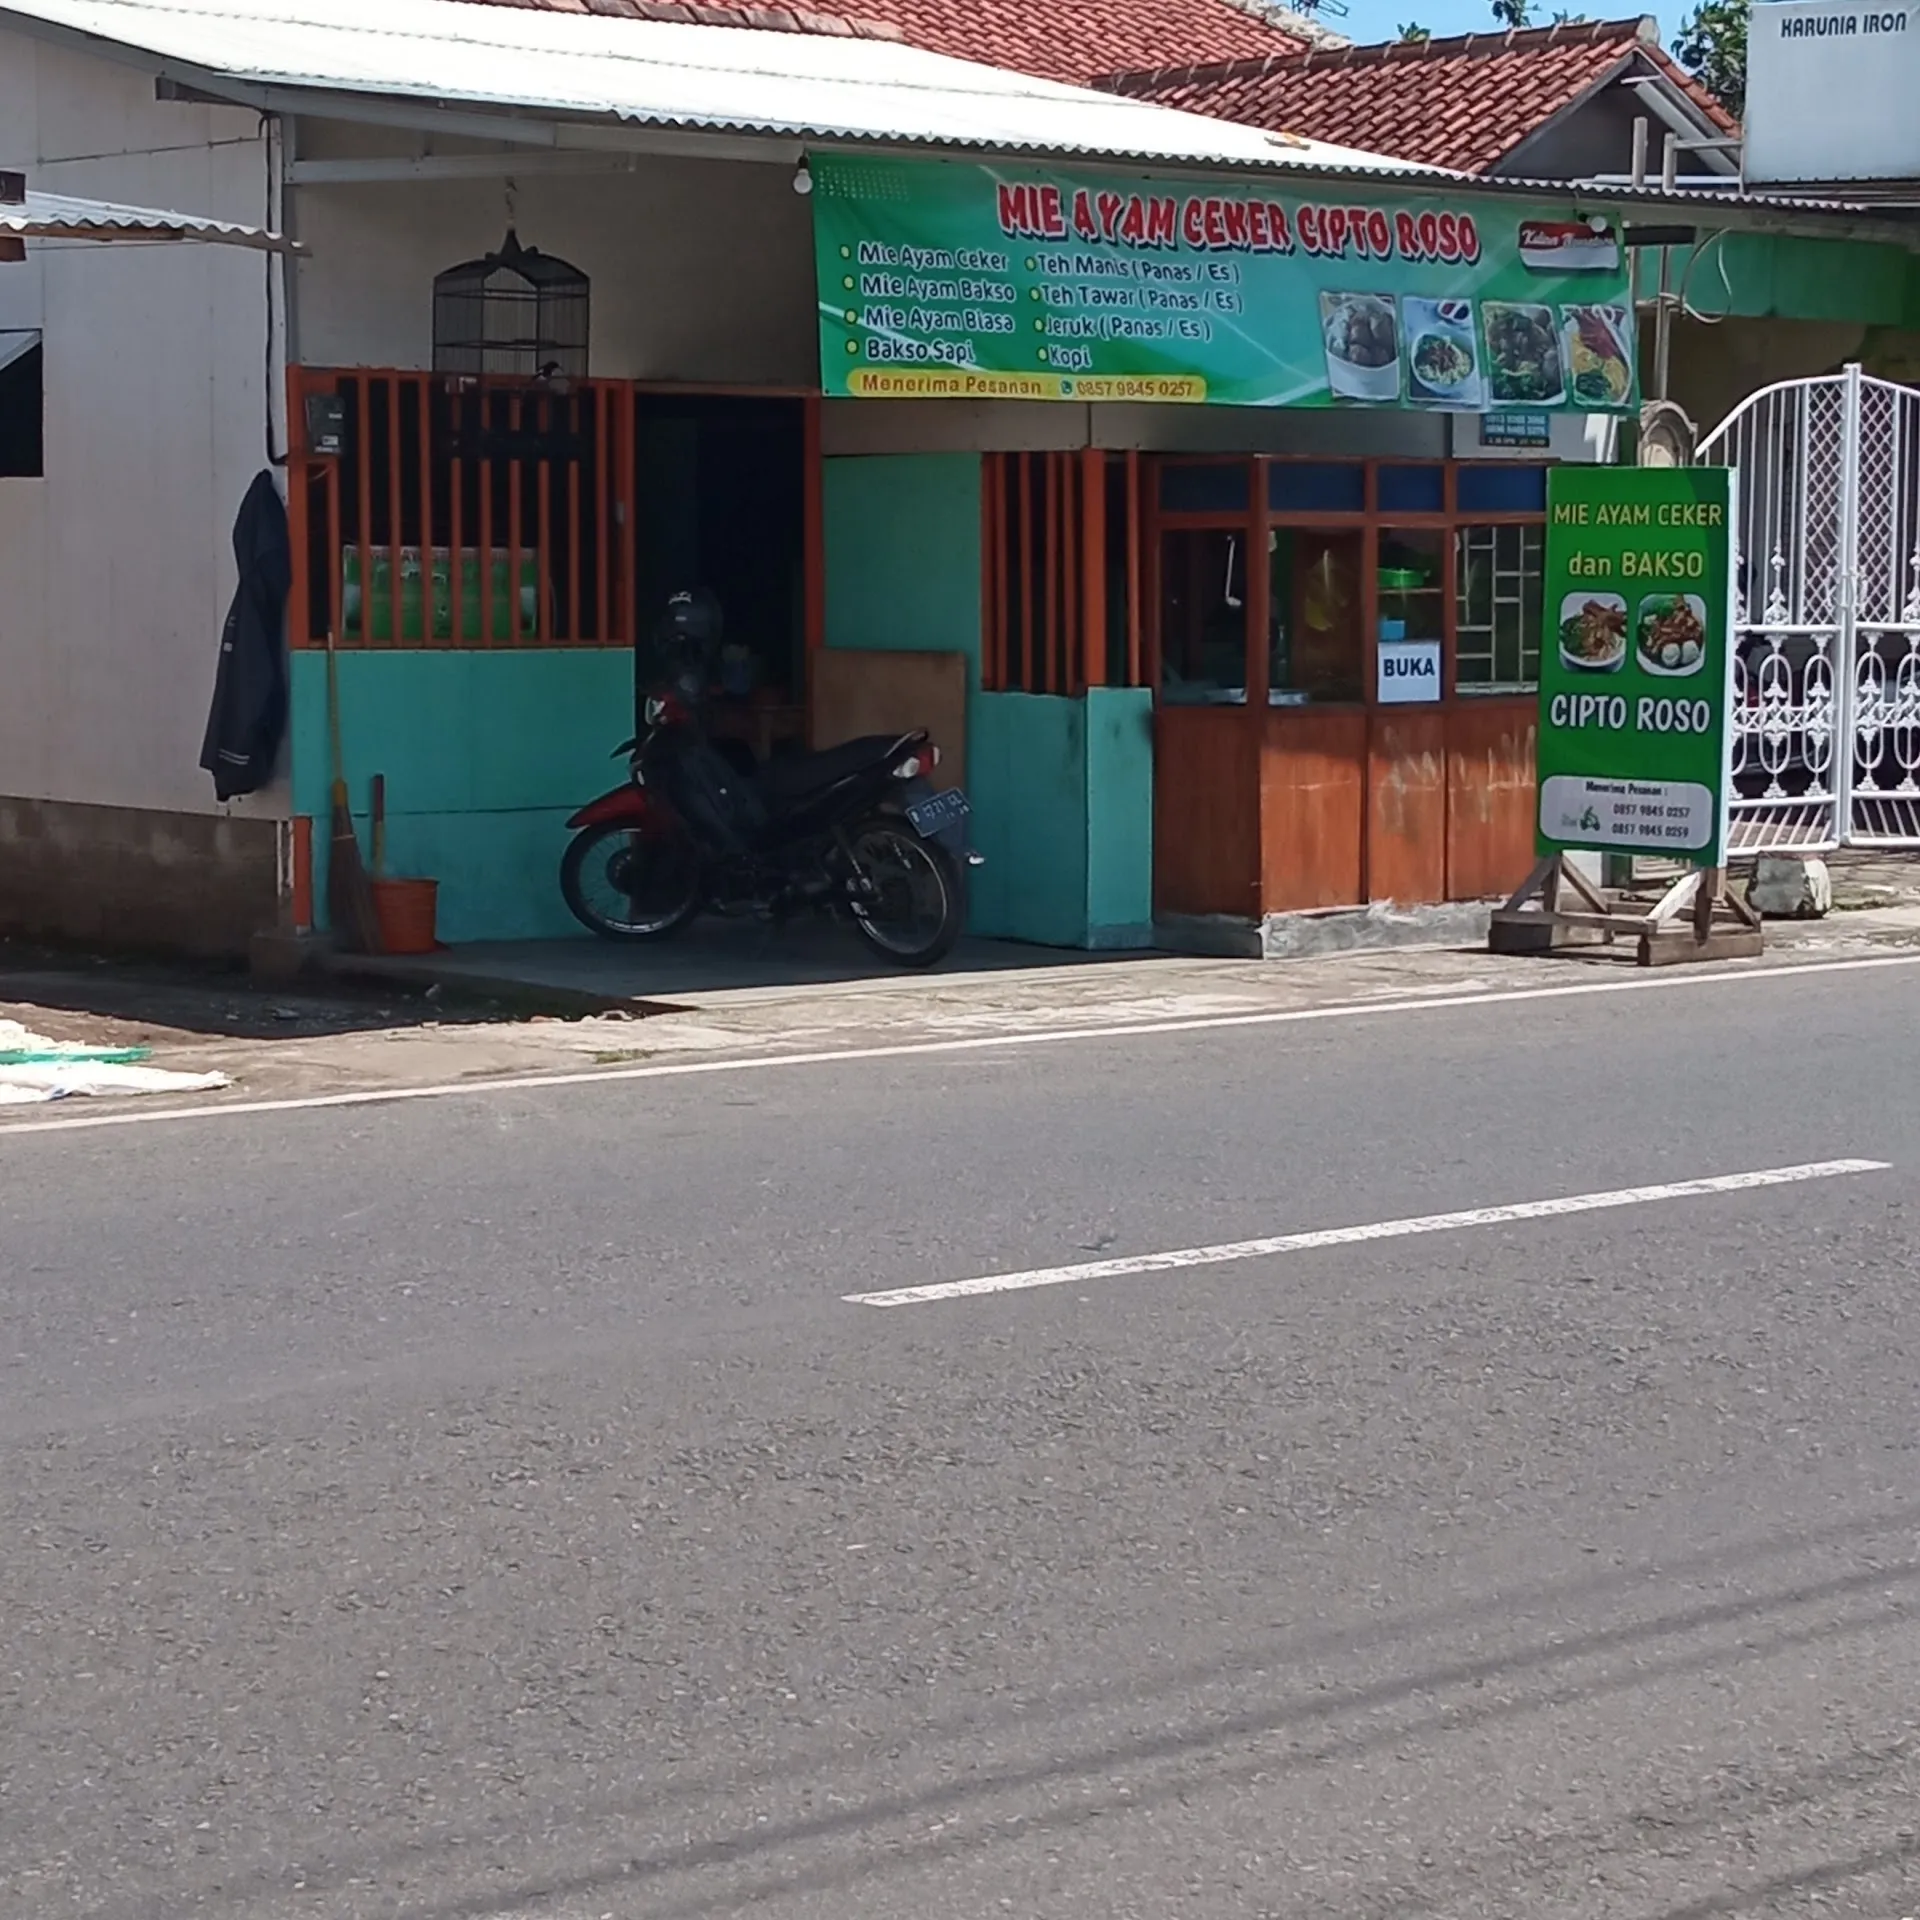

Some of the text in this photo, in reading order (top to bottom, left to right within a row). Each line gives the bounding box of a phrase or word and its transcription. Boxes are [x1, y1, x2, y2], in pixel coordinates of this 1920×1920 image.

[1781, 12, 1907, 38] KARUNIA IRON
[998, 182, 1067, 238] MIE
[1073, 190, 1174, 249] AYAM
[1297, 203, 1392, 261] CIPTO
[1395, 209, 1482, 265] ROSO
[859, 242, 1009, 271] Mie Ayam Ceker
[1037, 254, 1071, 275] Teh
[1075, 255, 1130, 278] Manis
[862, 273, 1016, 303] Mie Ayam Bakso
[1041, 285, 1074, 305] Teh
[1078, 286, 1136, 307] Tawar
[865, 305, 1015, 333] Mie Ayam Biasa
[1047, 315, 1095, 335] Jeruk
[867, 338, 976, 364] Bakso Sapi
[1049, 345, 1092, 371] Kopi
[862, 374, 1193, 397] Menerima Pesanan 0857 9845 0257
[1553, 504, 1722, 527] MIE AYAM CEKER
[1568, 550, 1704, 578] dan BAKSO
[1383, 657, 1436, 677] BUKA
[1550, 694, 1712, 734] CIPTO ROSO
[1613, 803, 1690, 819] 0857 9845 0257
[1611, 823, 1635, 835] 0857
[1639, 824, 1662, 837] 9845
